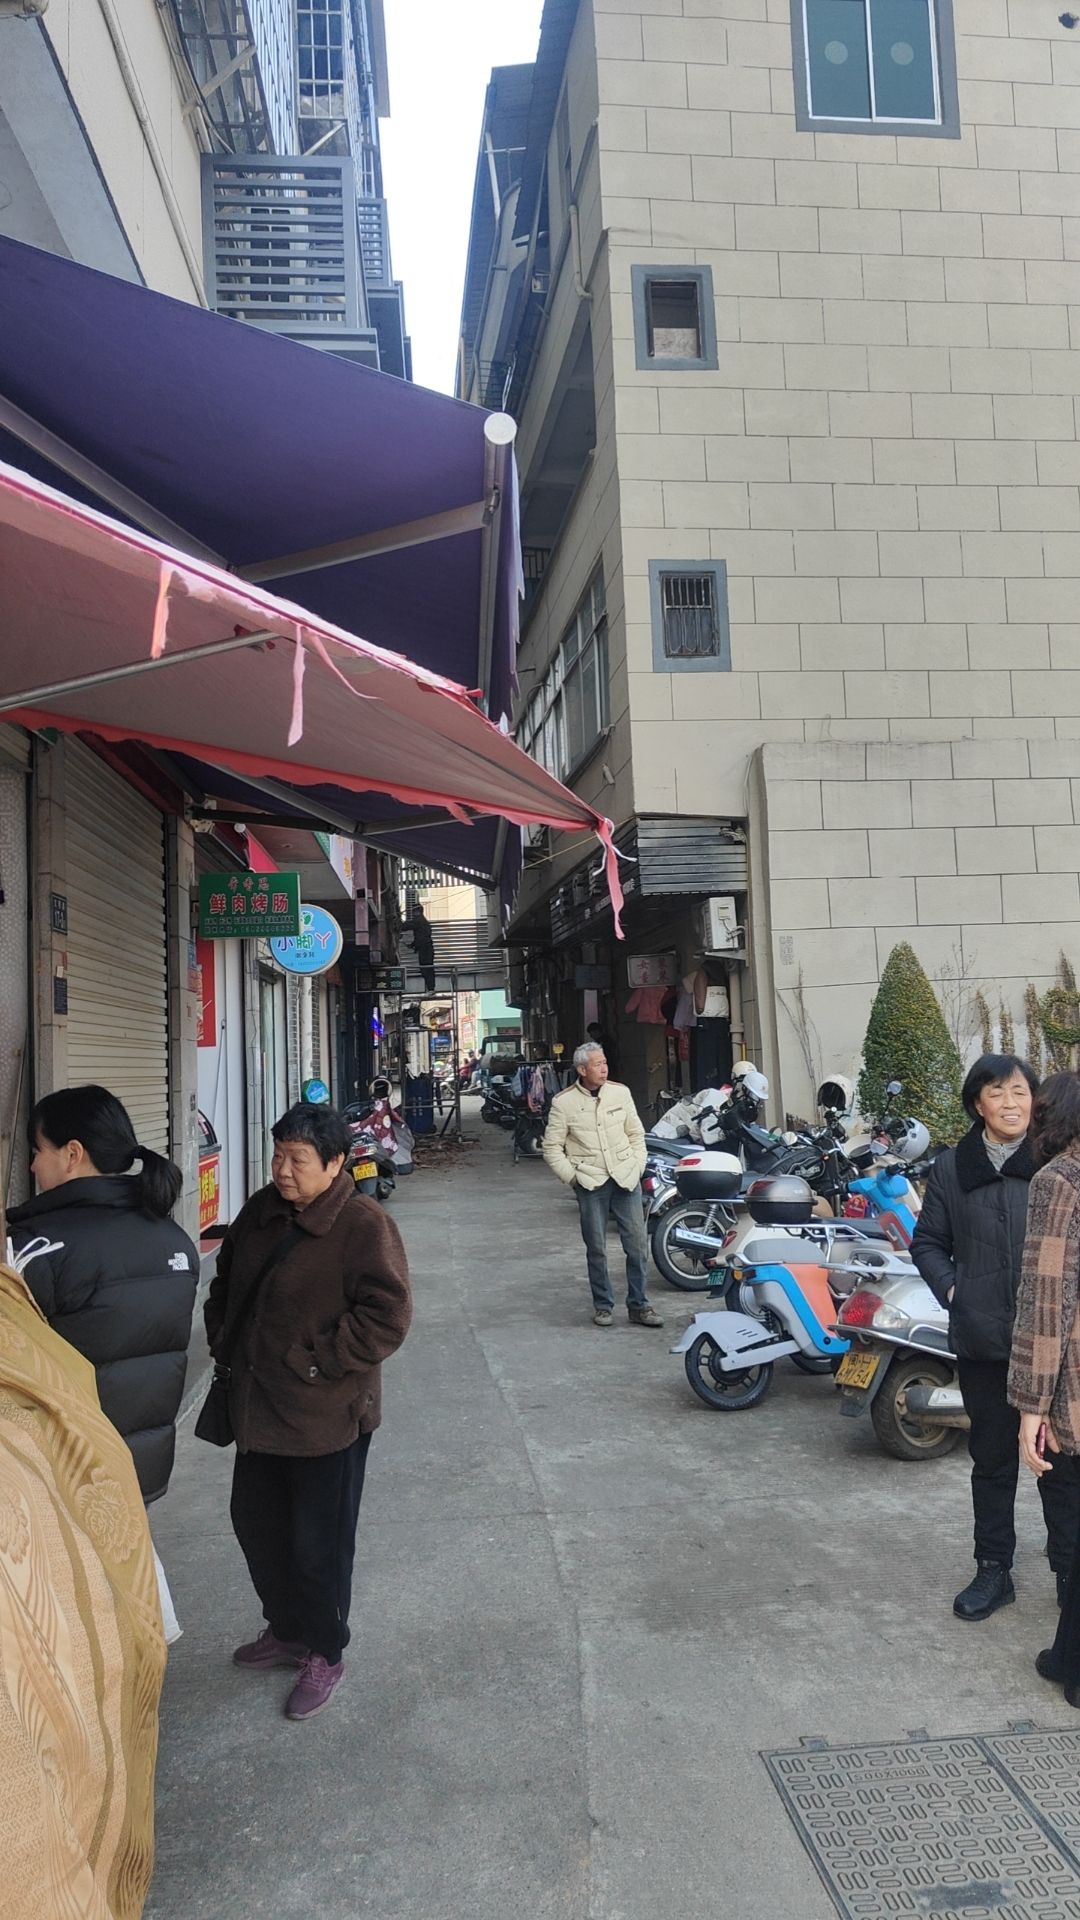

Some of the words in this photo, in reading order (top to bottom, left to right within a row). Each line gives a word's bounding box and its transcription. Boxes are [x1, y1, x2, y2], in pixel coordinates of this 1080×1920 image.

[209, 893, 288, 914] 鲜肉烤肠
[277, 931, 332, 952] 小脚丫
[199, 1168, 215, 1204] 烤肠
